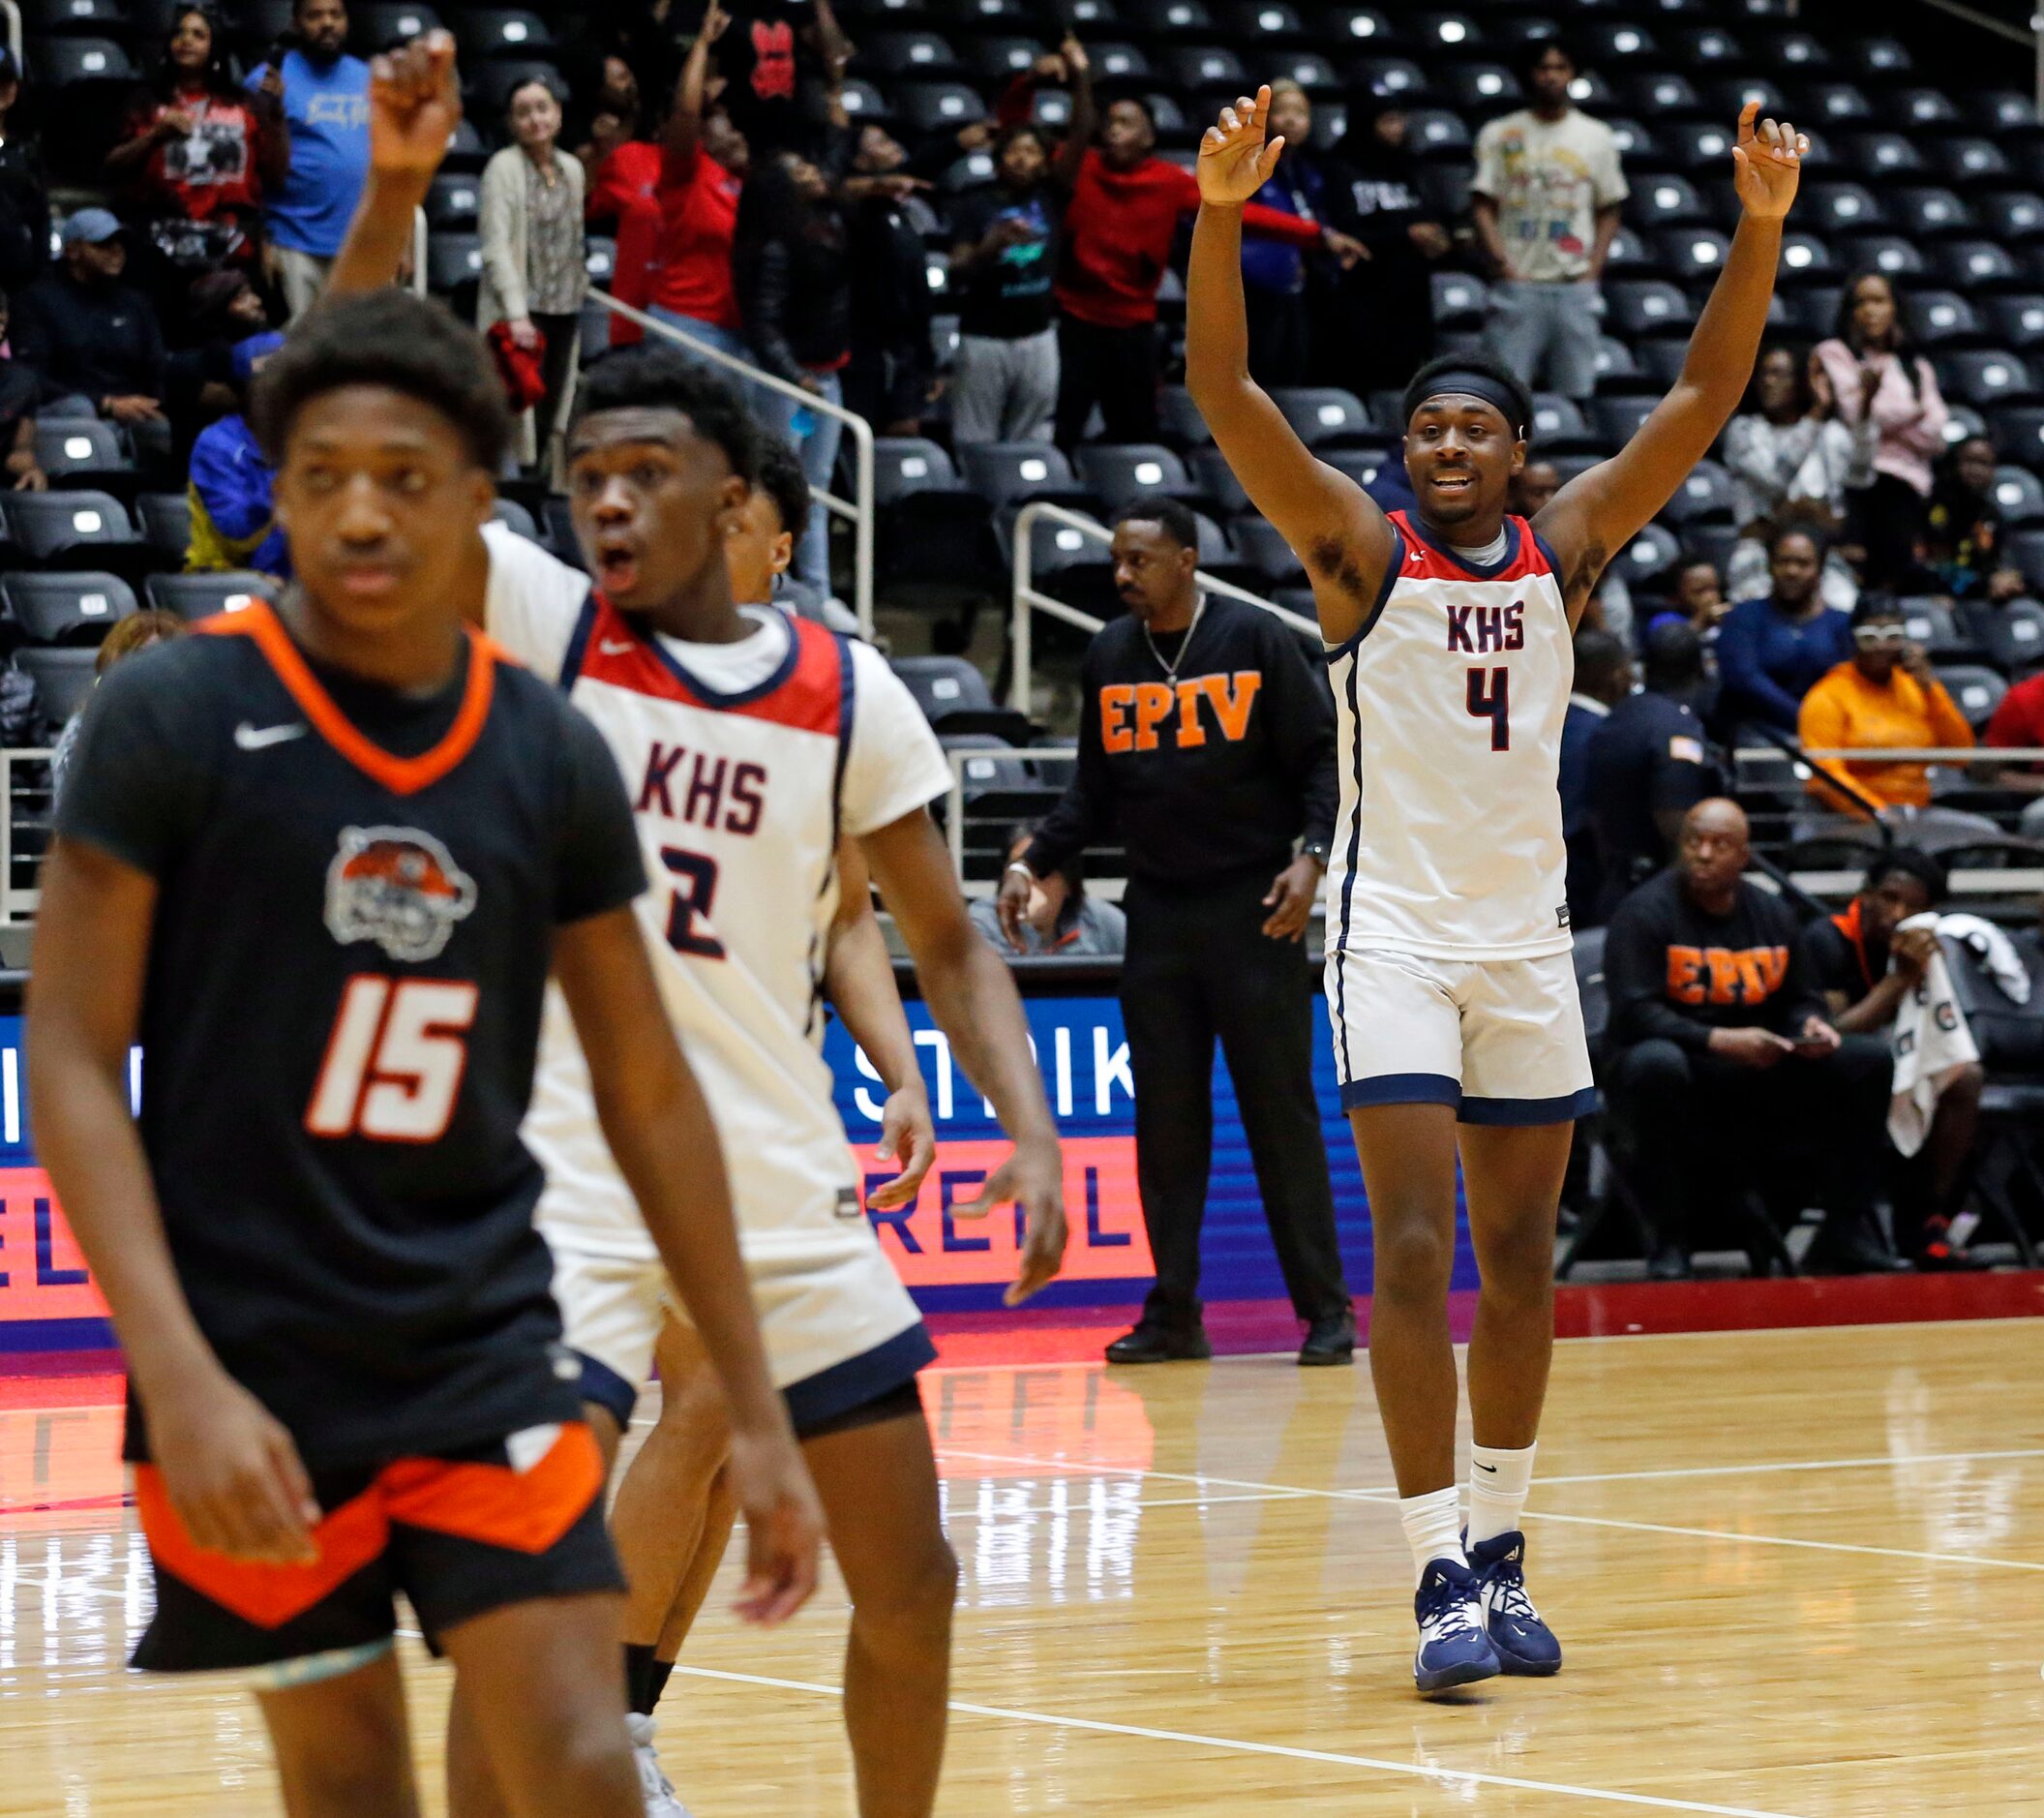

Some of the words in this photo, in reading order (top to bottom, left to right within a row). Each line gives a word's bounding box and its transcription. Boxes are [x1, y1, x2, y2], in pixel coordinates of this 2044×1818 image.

[1446, 600, 1524, 653] KHS
[1099, 670, 1262, 754] EPIV
[1466, 667, 1510, 752] 4
[635, 742, 767, 837] KHS
[660, 845, 725, 960] 2
[1667, 944, 1790, 1006] EPIV
[302, 972, 480, 1143] 15
